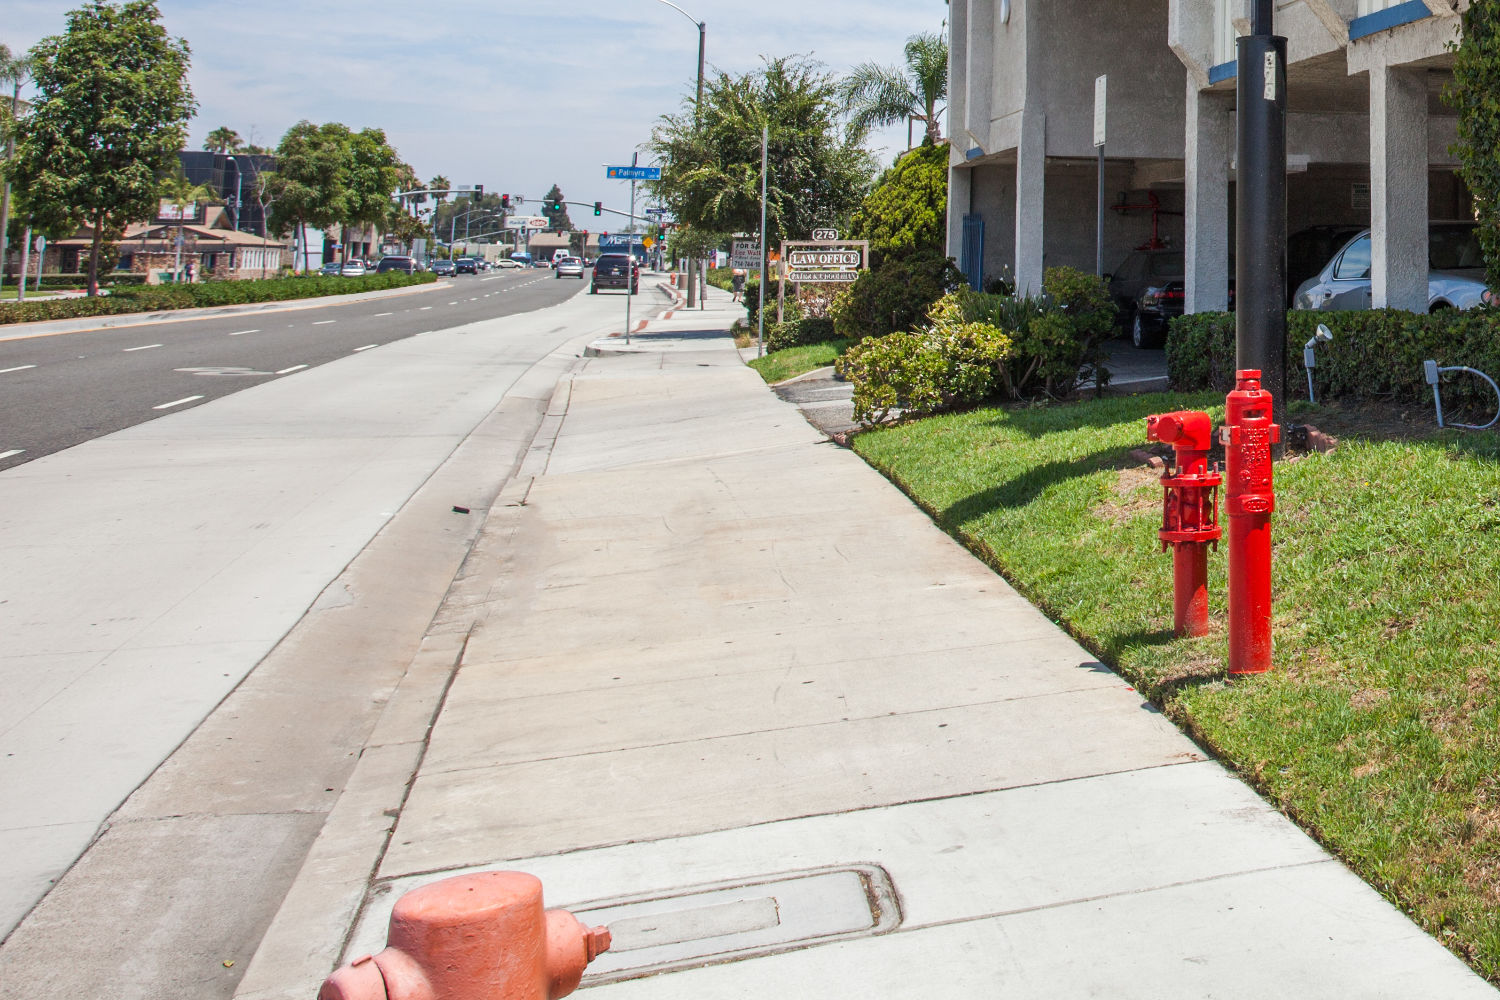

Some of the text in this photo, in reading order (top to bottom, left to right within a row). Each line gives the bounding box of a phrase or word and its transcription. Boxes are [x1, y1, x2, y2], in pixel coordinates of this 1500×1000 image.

[618, 169, 645, 177] Palmyra
[816, 230, 835, 239] 275
[793, 254, 857, 264] LAW OFFICE
